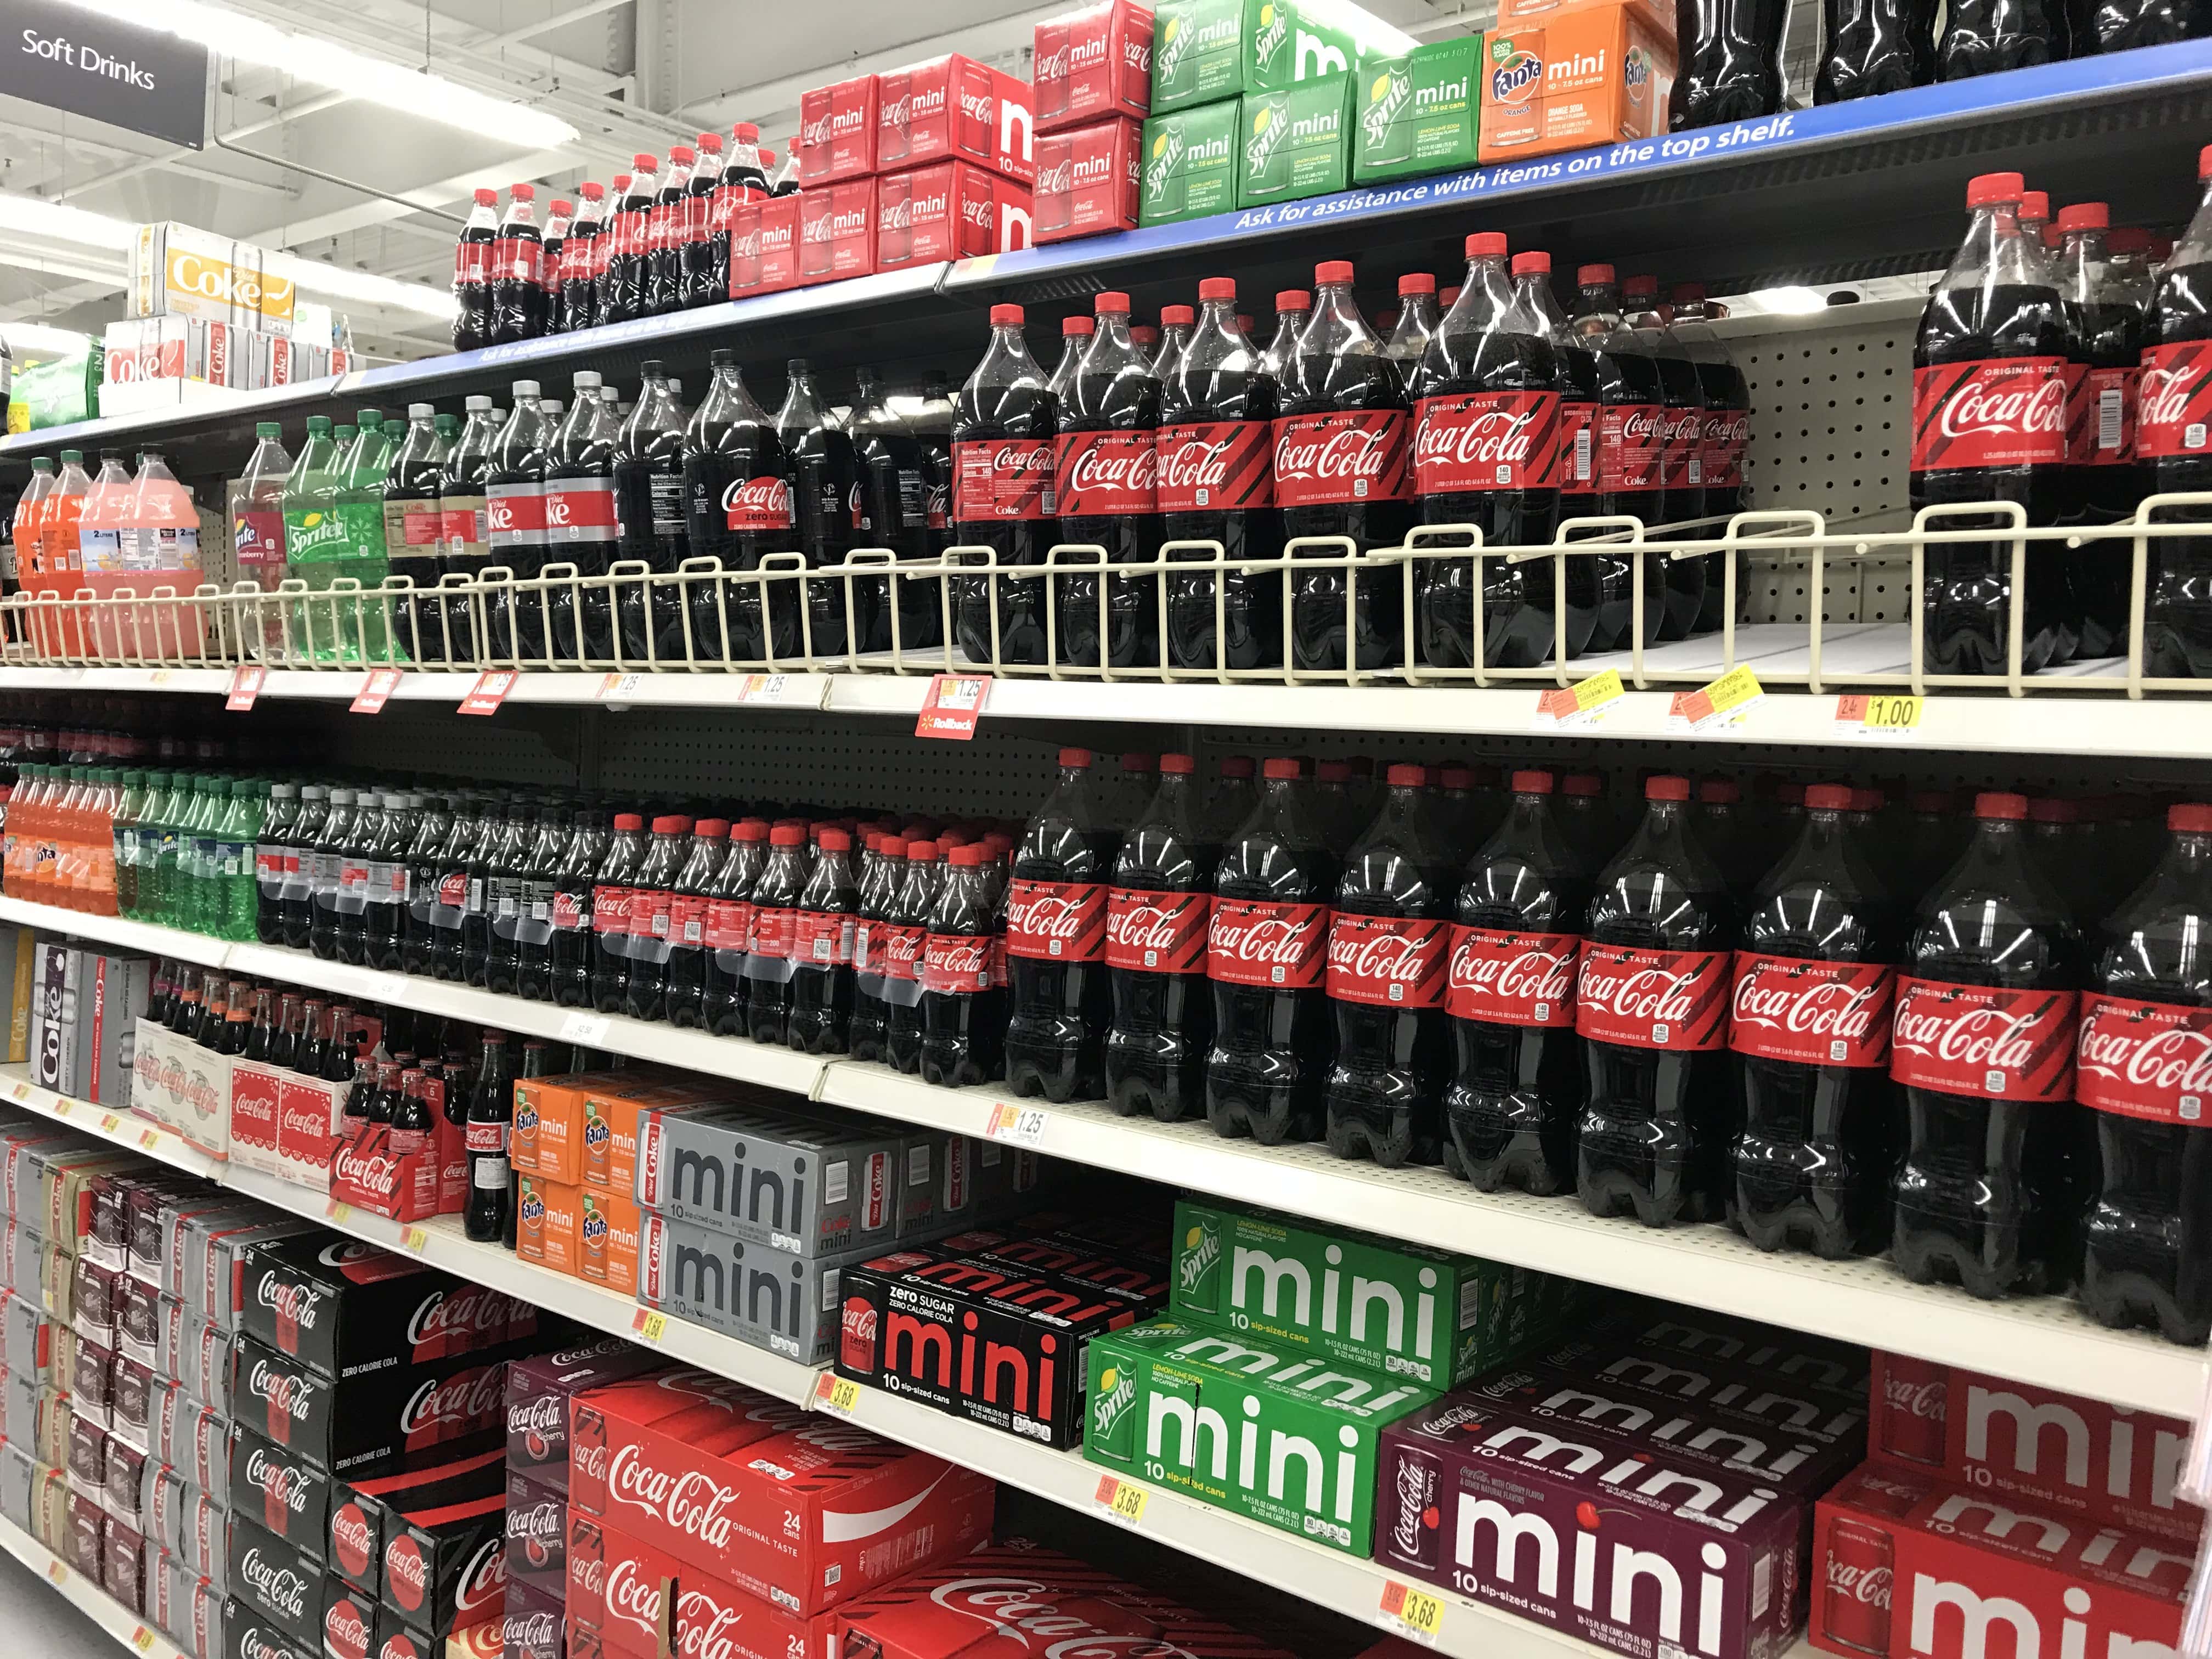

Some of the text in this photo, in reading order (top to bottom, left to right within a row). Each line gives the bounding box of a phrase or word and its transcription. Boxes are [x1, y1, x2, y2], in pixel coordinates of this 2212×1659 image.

[1071, 34, 1106, 62] mini
[1493, 42, 1511, 51] 100%
[21, 29, 156, 91] Soft Drinks
[1548, 49, 1605, 80] mini
[1416, 76, 1467, 105] mini
[833, 106, 863, 129] mini
[1363, 76, 1409, 146] Sprite
[1503, 105, 1530, 116] ORANGE
[1074, 152, 1110, 177] mini
[1235, 115, 1795, 230] Ask for assistance with items on the top shelf.
[912, 193, 946, 216] mini
[834, 208, 866, 232] mini
[762, 224, 792, 245] mini
[172, 255, 262, 308] Coke
[1984, 366, 2035, 376] ORIGINAL
[1430, 400, 1499, 411] ORIGINAL TASTE
[1289, 421, 1325, 430] ORIGINAL
[1415, 411, 1538, 469] Coca-Cola
[1274, 429, 1389, 482] Coca-Cola
[1623, 475, 1647, 486] Coke
[494, 500, 506, 509] Diet
[551, 495, 563, 504] Diet
[995, 505, 1019, 515] Coke
[746, 512, 768, 521] zero
[765, 676, 786, 693] 1.25
[959, 679, 982, 698] 1.25
[933, 716, 973, 731] Rollback
[1220, 904, 1277, 916] ORIGINAL TASTE
[1337, 918, 1395, 931] ORIGINAL TASTE
[1208, 913, 1312, 964] Coca-Cola
[1471, 934, 1542, 947] ORIGINAL TASTE
[913, 962, 924, 970] 200
[1327, 927, 1431, 981] Coca-Cola
[1591, 950, 1659, 964] ORIGINAL TASTE
[1449, 944, 1577, 1000] Coca-Cola
[1758, 962, 1839, 978] ORIGINAL TASTE
[1577, 960, 1702, 1022] Coca-Cola
[1911, 986, 1994, 1004] ORIGINAL TASTE
[1733, 973, 1880, 1037] Coca-Cola
[2097, 1004, 2189, 1025] ORIGINAL TASTE
[1892, 997, 2045, 1068] Coca-Cola
[517, 1110, 539, 1134] Fanta
[541, 1119, 567, 1137] mini
[1019, 1111, 1043, 1133] 1.25
[586, 1124, 610, 1147] Fanta
[336, 1147, 397, 1194] Coca-Cola
[672, 1142, 806, 1234] mini
[546, 1209, 573, 1228] mini
[671, 1204, 684, 1218] 10
[583, 1216, 607, 1239] Fanta
[610, 1228, 638, 1248] mini
[246, 1250, 254, 1260] 24
[1180, 1235, 1221, 1295] Sprite
[258, 1269, 321, 1329] Coca-Cola
[674, 1242, 804, 1339] mini
[889, 1286, 955, 1314] zero SUGAR
[1229, 1243, 1438, 1361] mini
[889, 1299, 953, 1323] ZERO CALORIE COLA
[645, 1316, 661, 1338] 3.68
[1229, 1312, 1309, 1343] 10 sip-sized cans
[342, 1356, 398, 1377] ZERO CALORIE COLA
[884, 1310, 1057, 1422] mini
[1153, 1363, 1203, 1384] LEMON-LIME SODA
[250, 1359, 314, 1421] Coca-Cola
[883, 1373, 950, 1404] 10 sip-sized cans
[1160, 1379, 1178, 1389] CAFFEINE
[1093, 1376, 1136, 1433] Sprite
[543, 1429, 566, 1441] cherry
[336, 1446, 391, 1470] ZERO CALORIE COLA
[1146, 1389, 1360, 1525] mini
[1471, 1444, 1547, 1474] 10 sip-sized
[1144, 1460, 1164, 1480] 10
[1206, 1486, 1226, 1499] cans
[1425, 1469, 1435, 1503] cherry
[1460, 1466, 1544, 1502] Coca-Cola WITH CHERRY FLAVOR
[609, 1444, 741, 1549] Coca-Cola
[1465, 1480, 1480, 1490] OTHER
[1481, 1485, 1503, 1498] NATURAL
[1503, 1492, 1525, 1504] FLAVORS
[784, 1510, 800, 1532] 24
[541, 1537, 563, 1549] cherry
[732, 1521, 798, 1558] ORIGINAL TASTE
[783, 1528, 800, 1540] cans
[242, 1548, 308, 1617] Coca-Cola
[1455, 1492, 1728, 1659] mini
[257, 1592, 271, 1607] zero
[1453, 1570, 1556, 1619] 10 sip-sized cans
[1577, 1614, 1623, 1639] 10-7.5 CANS
[787, 1634, 805, 1656] 24
